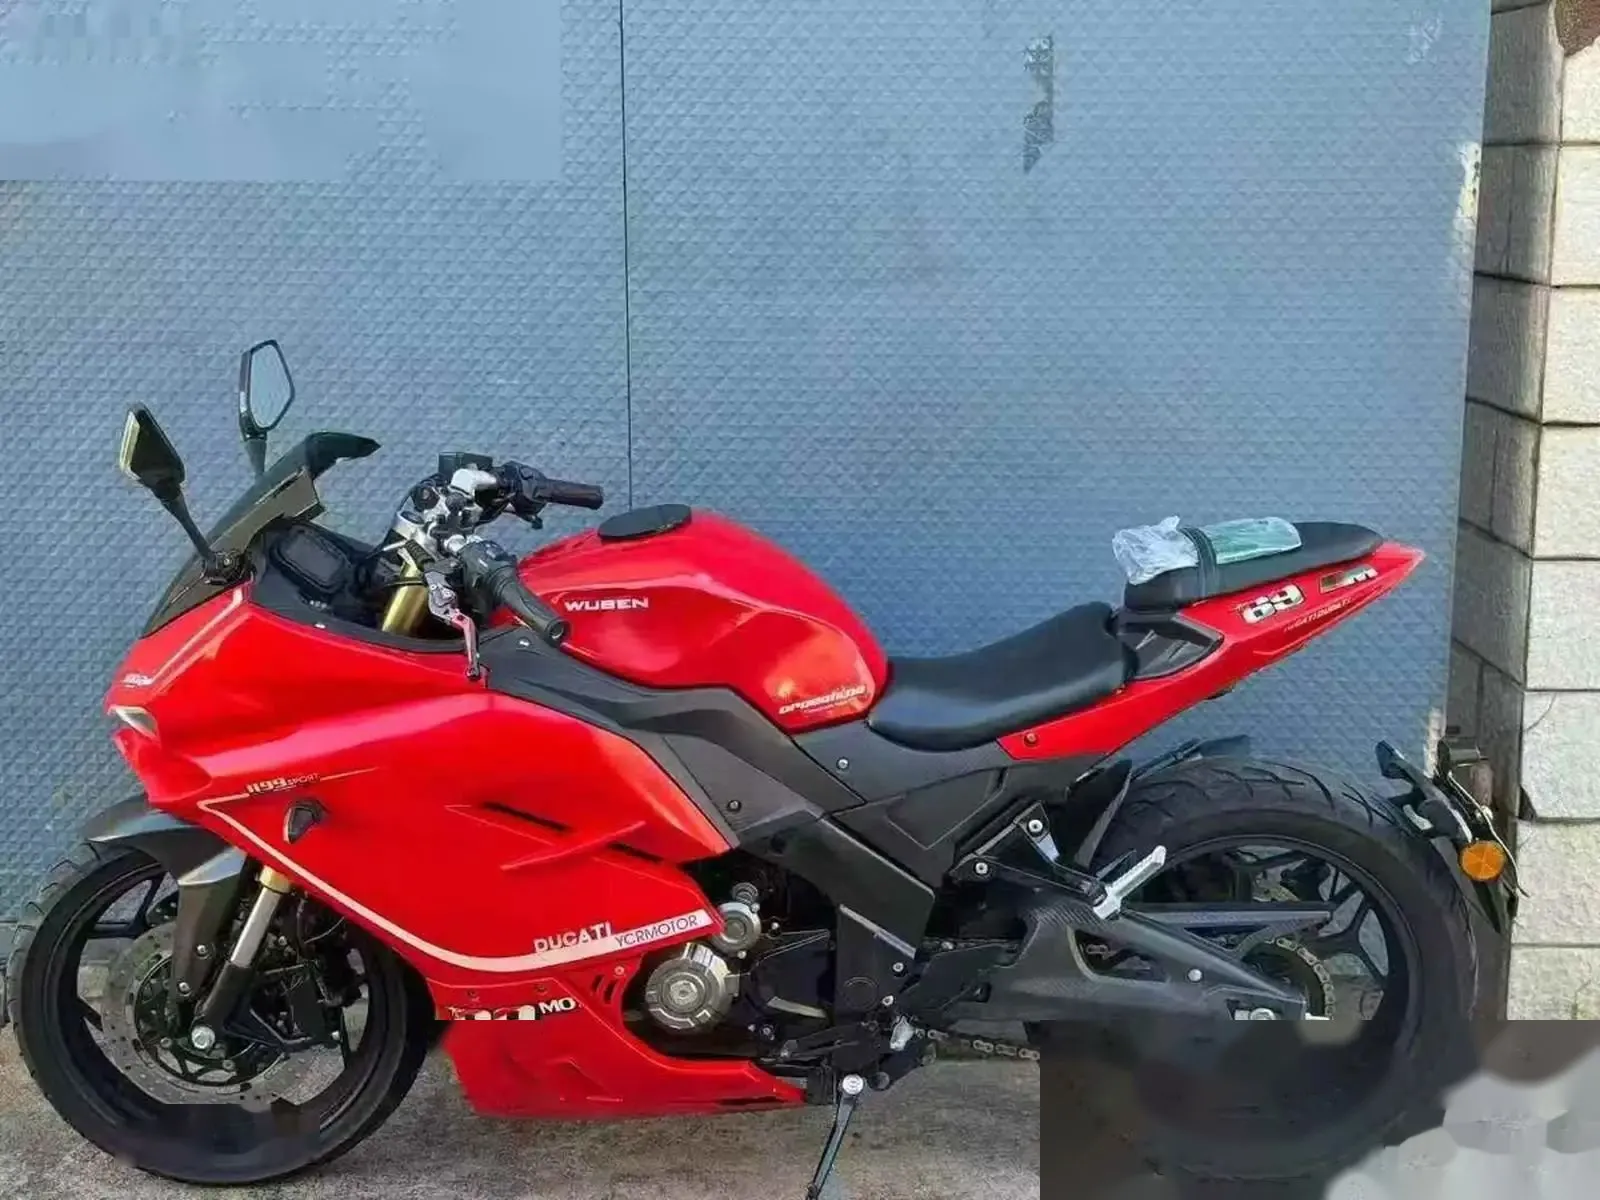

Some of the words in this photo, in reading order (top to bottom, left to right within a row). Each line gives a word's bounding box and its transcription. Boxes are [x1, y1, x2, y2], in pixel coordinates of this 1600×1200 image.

[564, 597, 649, 612] WUBEN
[533, 922, 612, 953] DUCATI
[615, 914, 698, 947] YCRMOTOR
